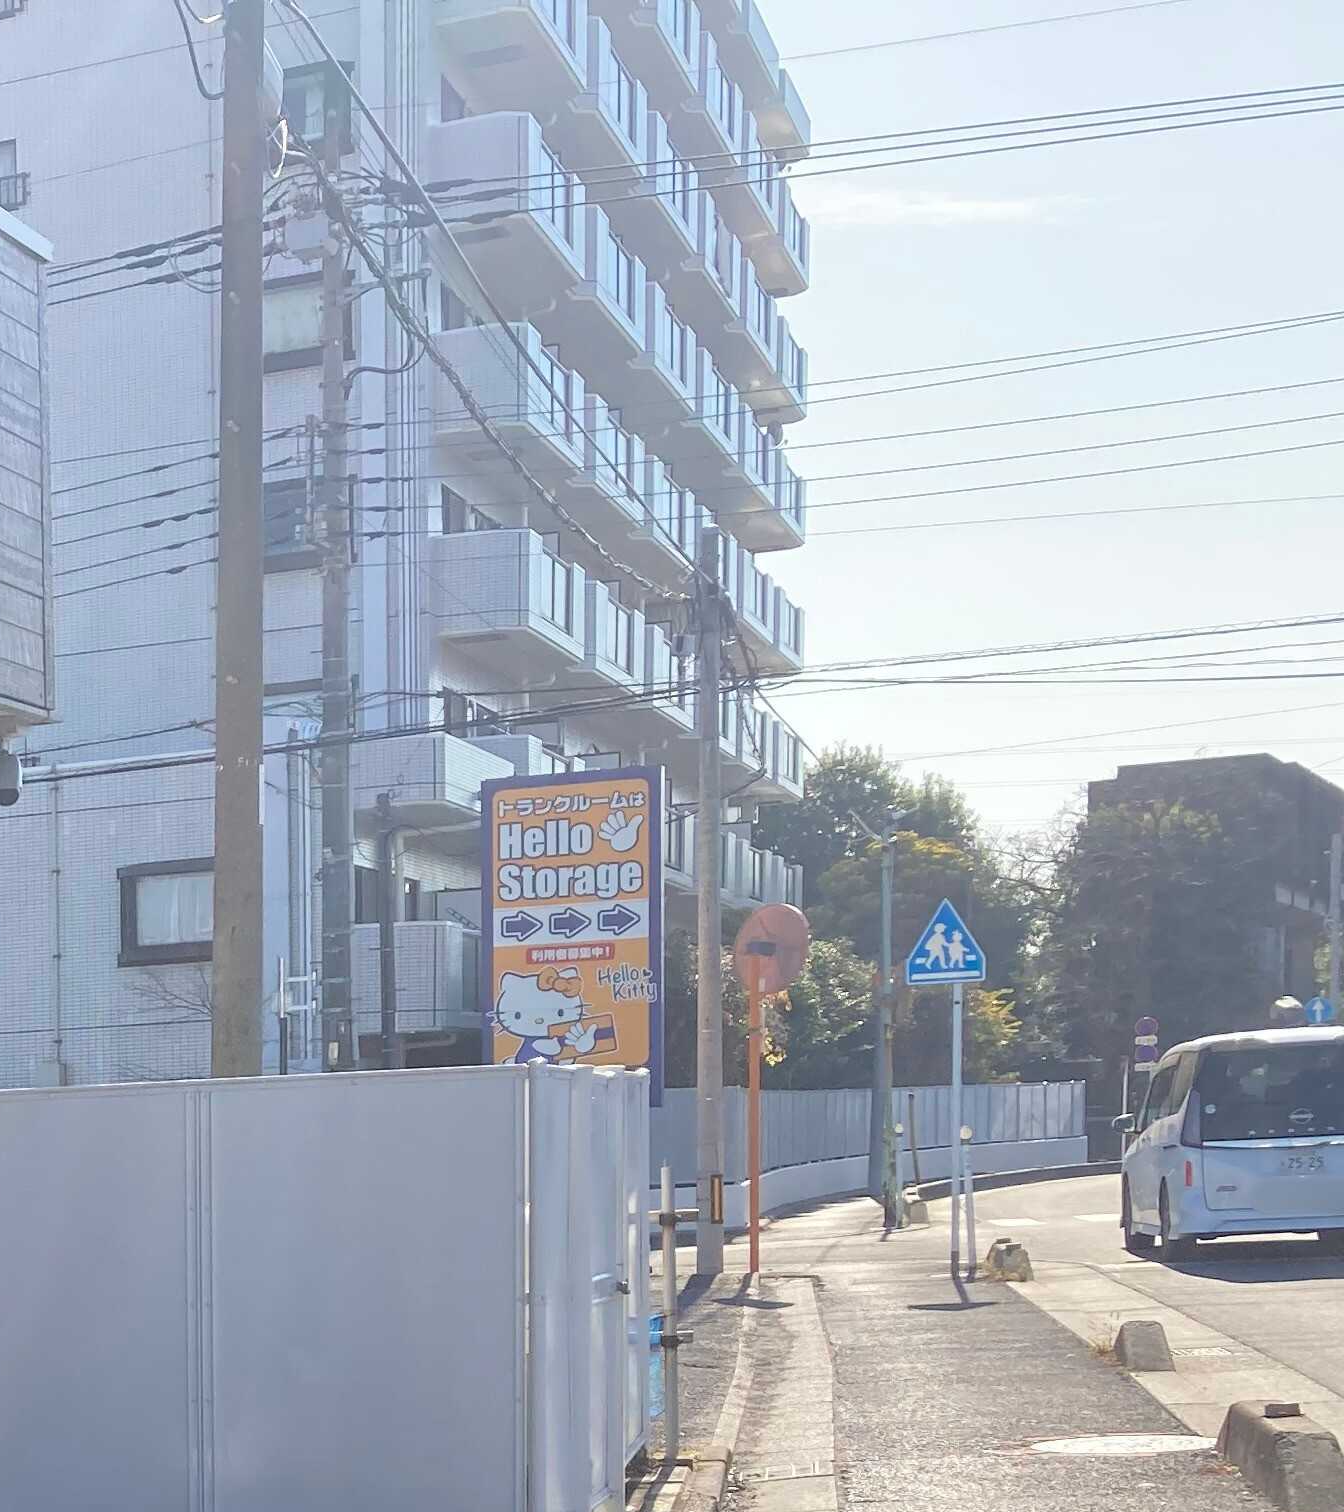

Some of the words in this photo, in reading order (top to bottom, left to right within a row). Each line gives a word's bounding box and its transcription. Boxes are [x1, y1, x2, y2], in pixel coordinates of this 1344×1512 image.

[498, 791, 645, 817] トランクルームは
[498, 818, 594, 860] Hello
[498, 860, 644, 901] Storage
[598, 963, 639, 985] Hello
[613, 982, 657, 1001] Kitty
